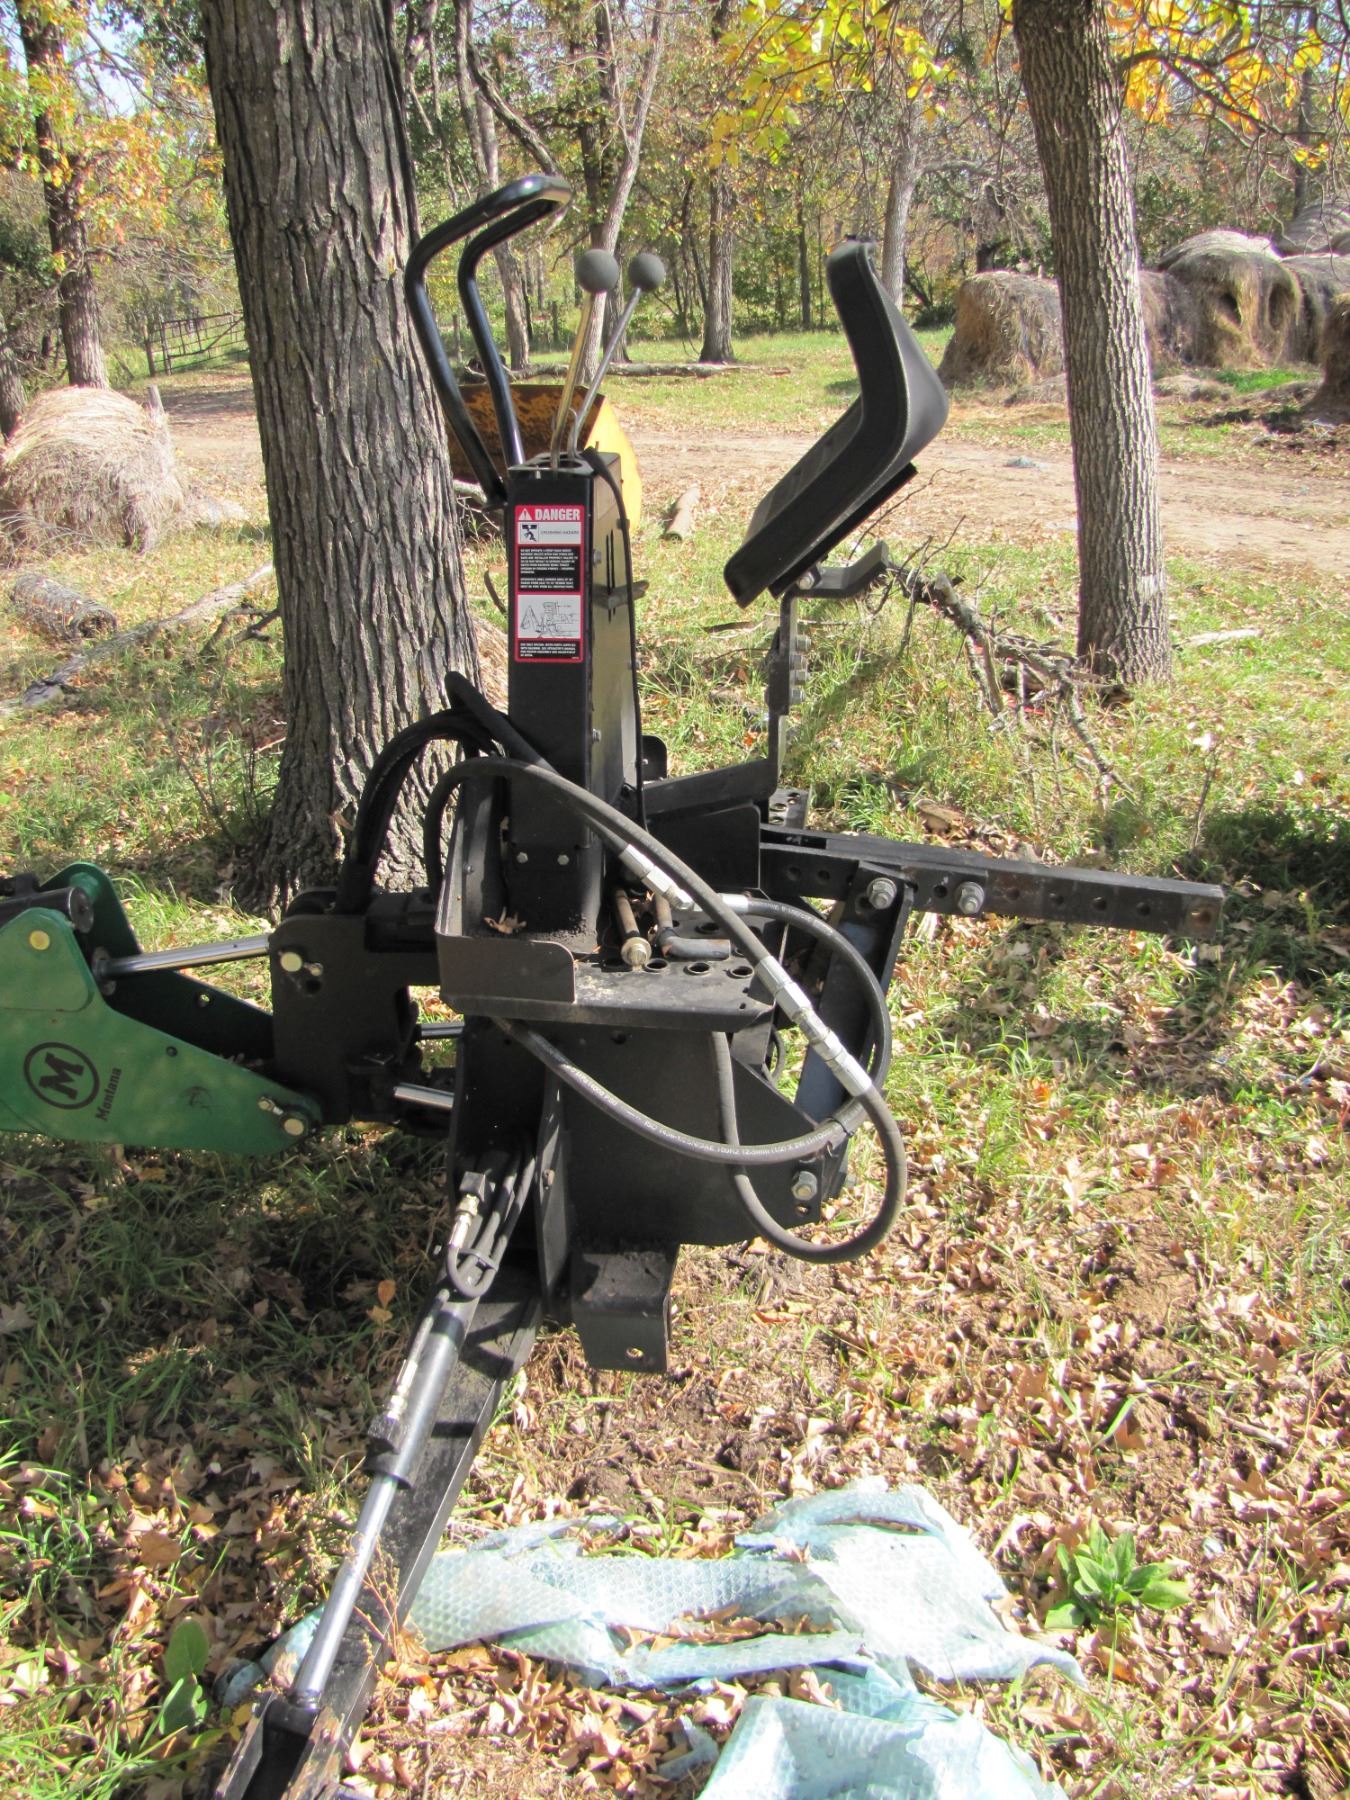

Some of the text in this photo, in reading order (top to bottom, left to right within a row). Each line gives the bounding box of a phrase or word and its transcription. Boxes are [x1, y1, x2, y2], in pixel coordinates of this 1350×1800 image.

[535, 508, 580, 521] DANGER
[39, 1052, 84, 1100] M
[95, 1066, 122, 1121] Montana
